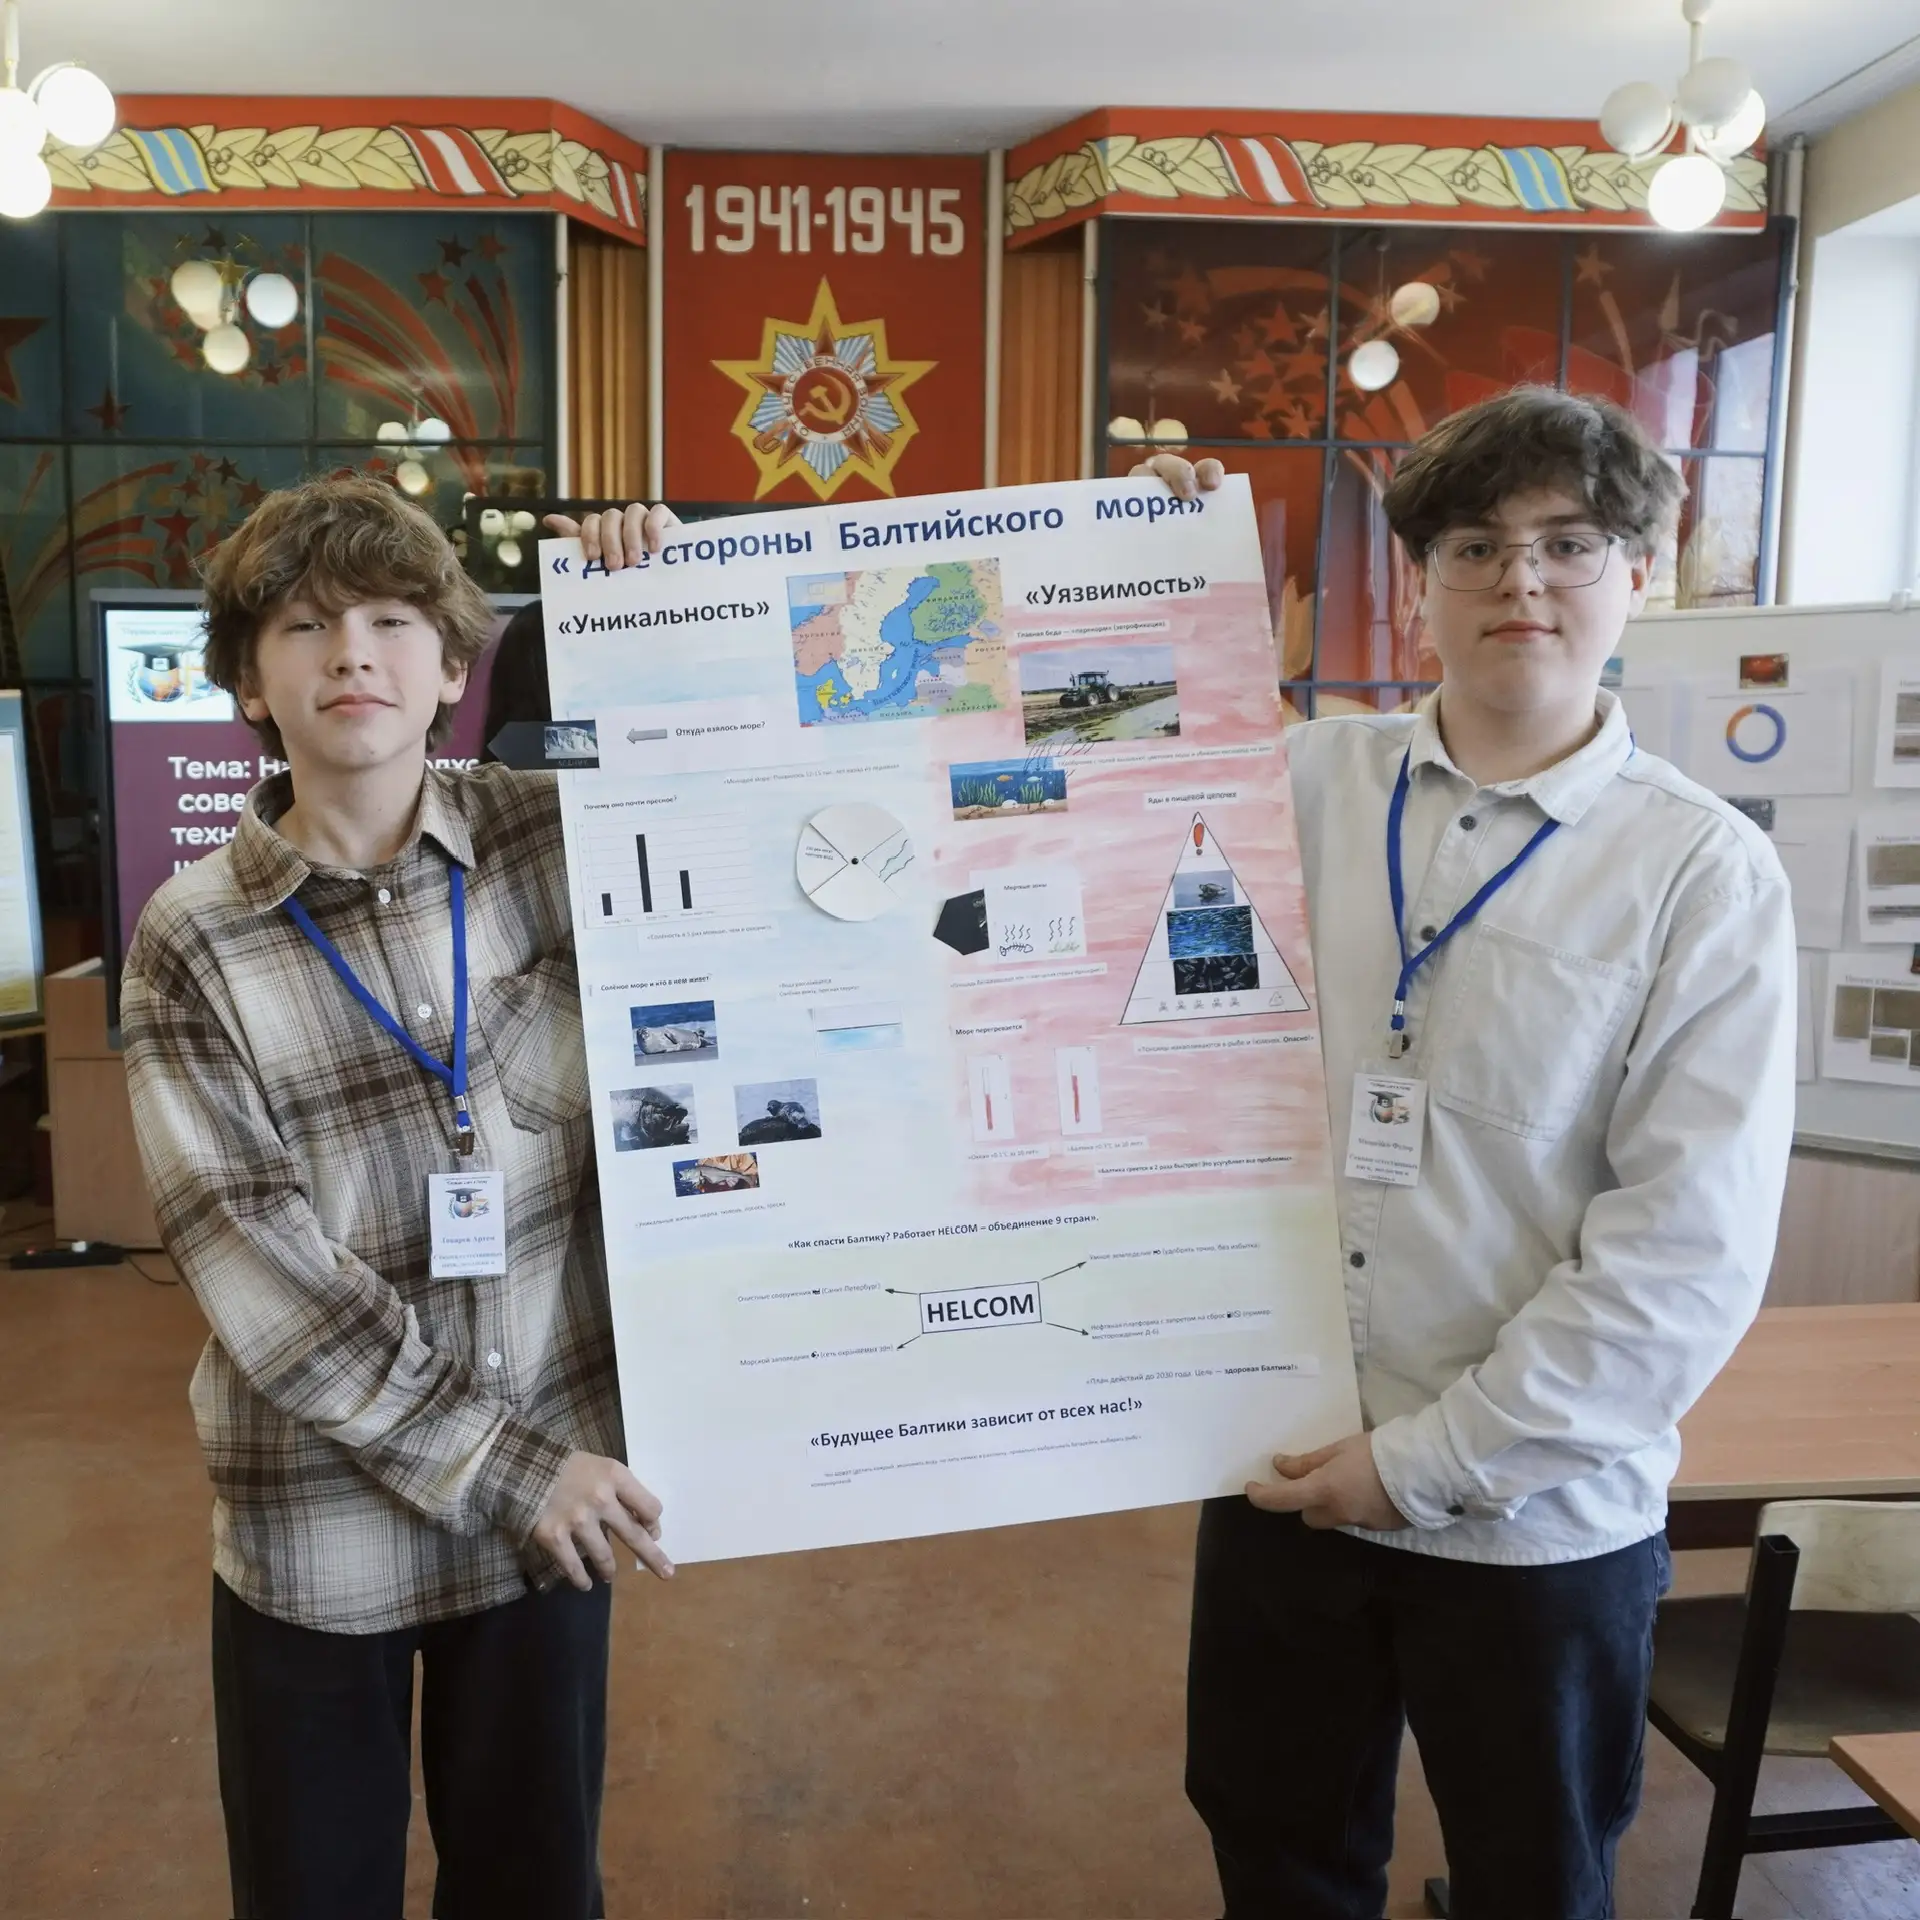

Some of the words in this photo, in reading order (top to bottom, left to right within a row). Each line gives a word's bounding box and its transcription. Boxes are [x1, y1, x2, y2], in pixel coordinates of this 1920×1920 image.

[686, 184, 964, 256] 1941-1945
[662, 530, 812, 566] стороны
[840, 507, 1064, 550] Балтийского
[1096, 495, 1205, 523] моря»
[1026, 574, 1206, 606] «Уязвимость»
[558, 600, 770, 636] «Уникальность»
[675, 726, 705, 738] Откуда
[707, 724, 739, 735] взялось
[740, 721, 766, 734] море?
[167, 756, 252, 780] Тема:
[584, 802, 610, 811] Почему
[625, 799, 646, 808] почти
[630, 982, 649, 992] море
[955, 1028, 974, 1036] Море
[975, 1024, 1023, 1035] перегревается
[788, 1237, 812, 1250] «Как
[814, 1236, 845, 1248] спасти
[847, 1231, 891, 1246] Балтику?
[893, 1227, 936, 1241] Работает
[937, 1223, 978, 1238] HELCOM
[988, 1215, 1053, 1234] объединение
[1055, 1216, 1062, 1225] 9
[1063, 1213, 1099, 1226] стран».
[927, 1292, 1035, 1324] HELCOM
[1207, 1312, 1226, 1321] сброс
[740, 1357, 770, 1367] Морской
[1110, 1372, 1144, 1384] действий
[1145, 1373, 1155, 1381] до
[1156, 1370, 1173, 1379] 2030
[1194, 1368, 1213, 1378] Цель
[1224, 1365, 1260, 1376] здоровая
[811, 1428, 894, 1449] «Будущее
[898, 1417, 967, 1437] Балтики
[970, 1410, 1033, 1429] зависит
[1037, 1408, 1056, 1422] от
[1060, 1402, 1096, 1419] всех
[1099, 1396, 1143, 1414] нас!»
